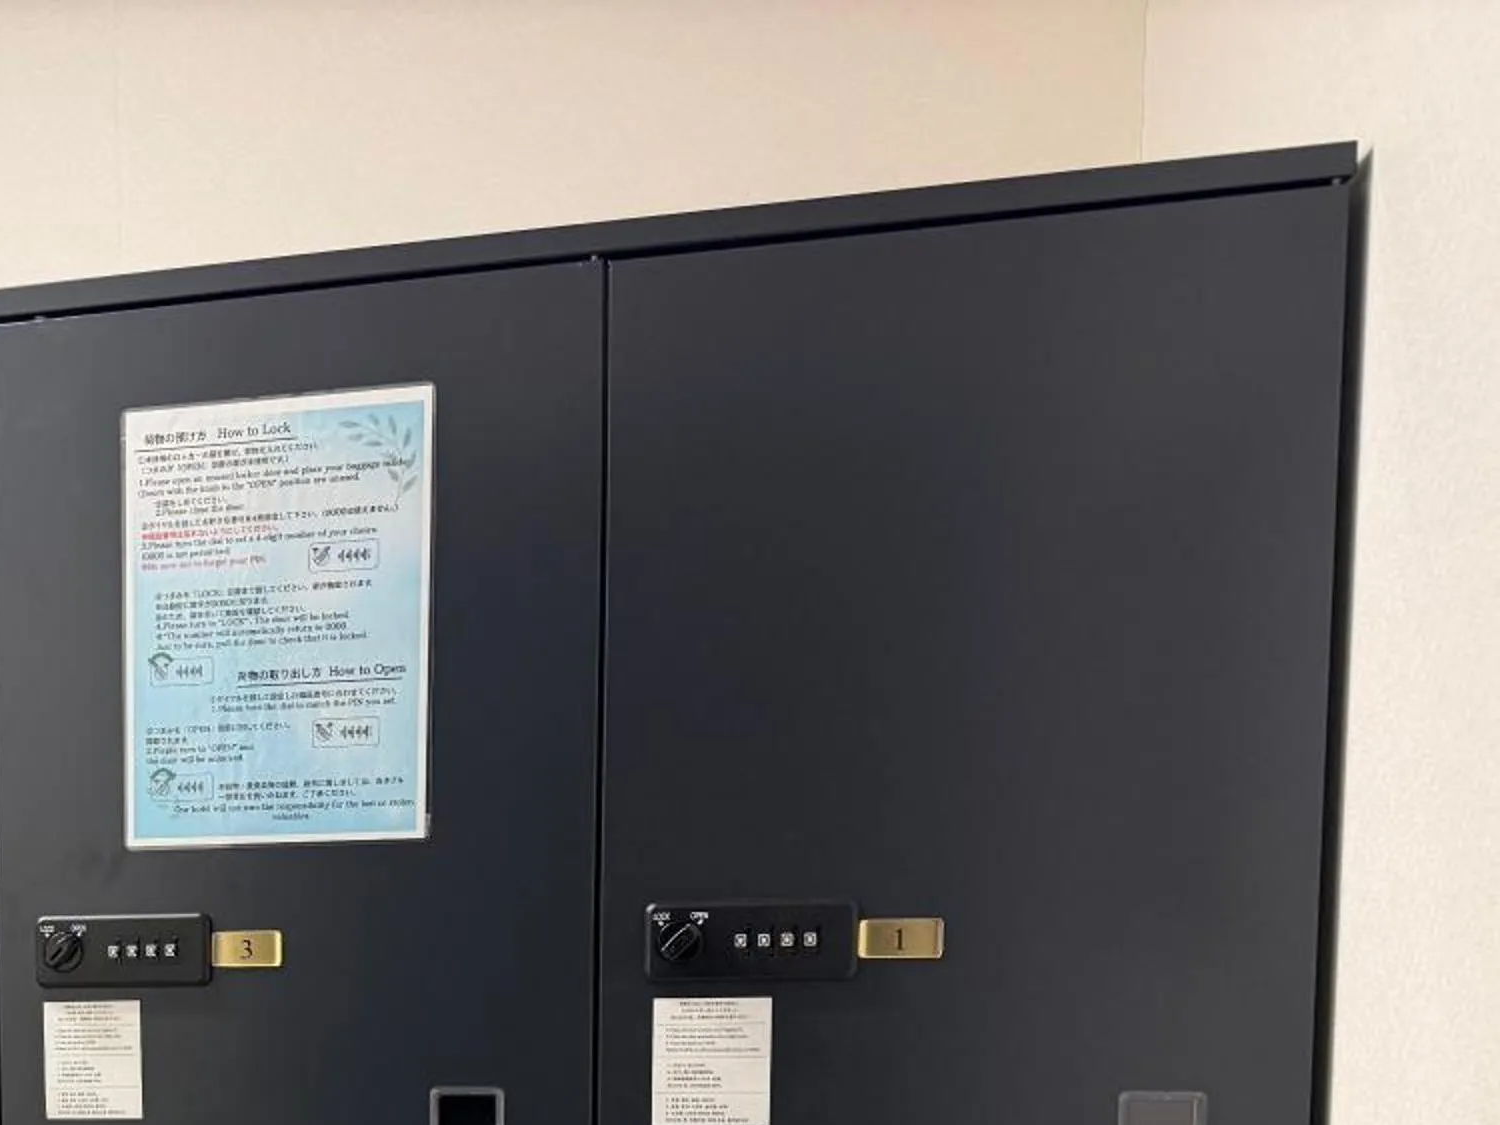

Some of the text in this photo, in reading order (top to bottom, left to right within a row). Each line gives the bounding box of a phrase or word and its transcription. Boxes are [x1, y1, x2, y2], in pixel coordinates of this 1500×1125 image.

[217, 426, 244, 440] How
[247, 423, 259, 437] to
[262, 421, 292, 435] Lock
[329, 664, 356, 678] How
[359, 663, 372, 676] to
[373, 662, 407, 677] Open
[240, 939, 254, 960] 3
[894, 929, 904, 951] 1
